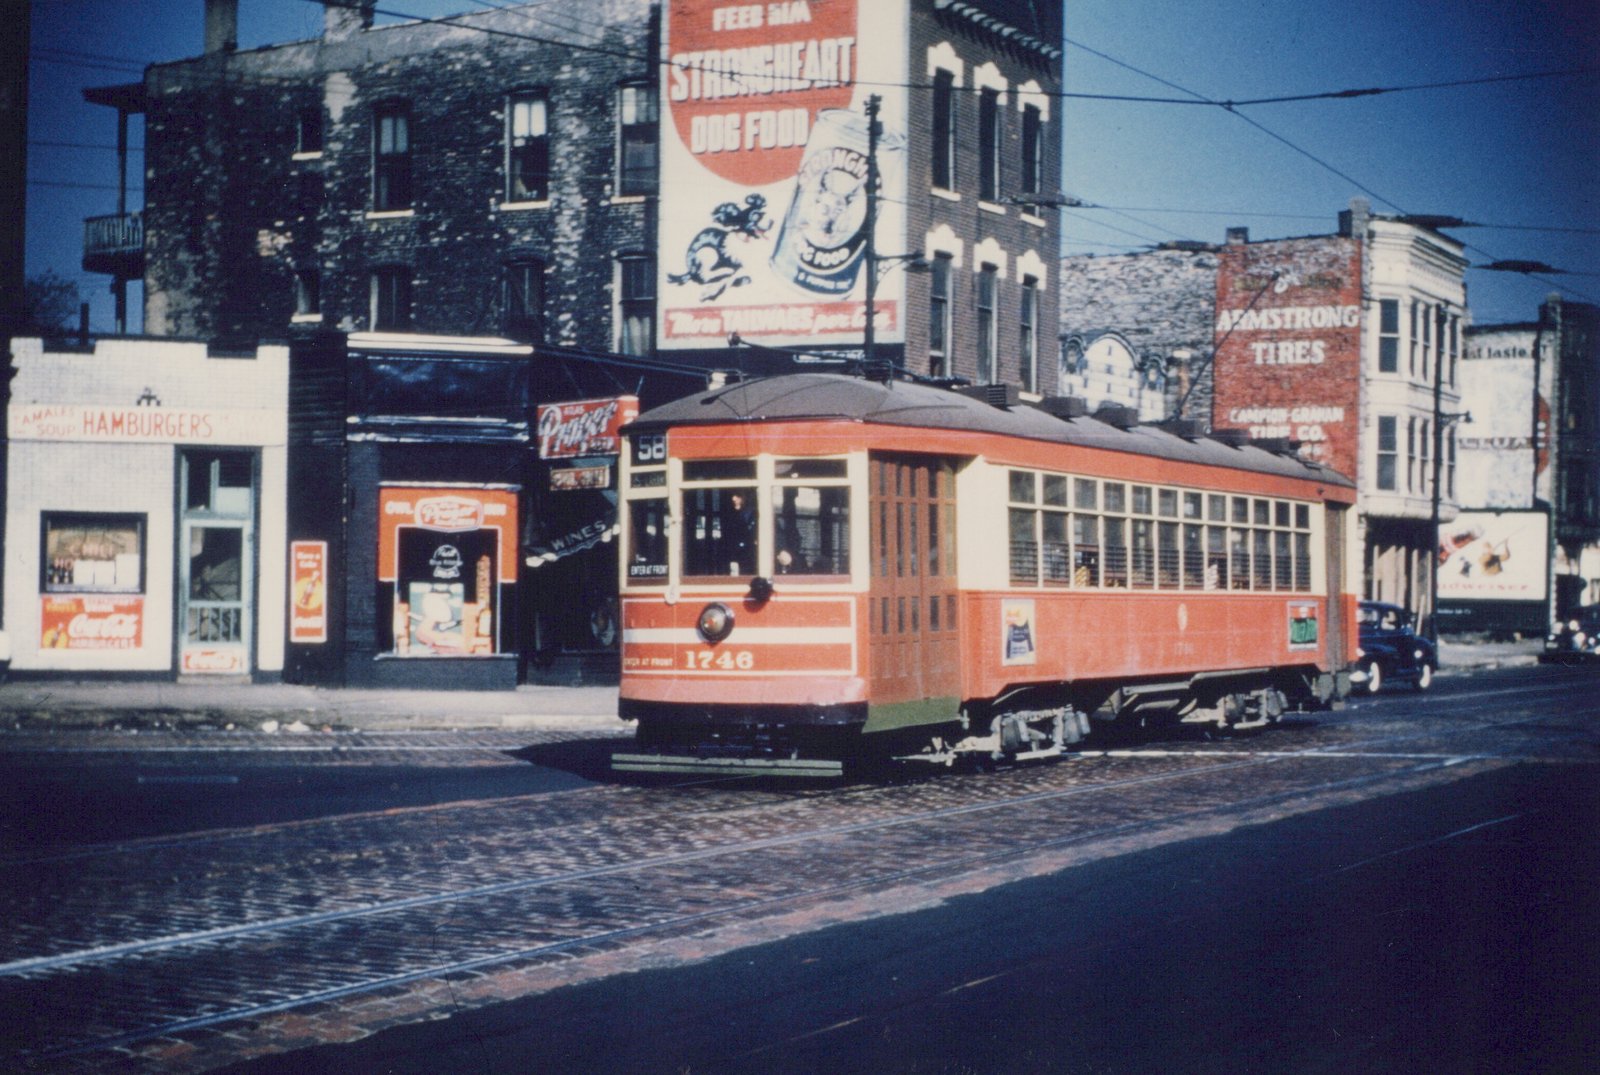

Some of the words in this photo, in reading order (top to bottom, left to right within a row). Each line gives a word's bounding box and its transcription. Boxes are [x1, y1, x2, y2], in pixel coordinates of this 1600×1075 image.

[671, 37, 856, 103] STRONGHEART
[691, 113, 741, 154] DOG
[745, 108, 809, 151] FOOD
[1216, 305, 1360, 331] ARMSTRONG
[1252, 340, 1325, 365] TIRES
[36, 423, 76, 436] SOUP
[82, 410, 213, 439] HAMBURGERS
[1297, 424, 1327, 441] CO.
[551, 520, 606, 551] WINES
[631, 565, 646, 576] ENTER
[653, 564, 667, 575] FRONT
[685, 650, 754, 670] 1746
